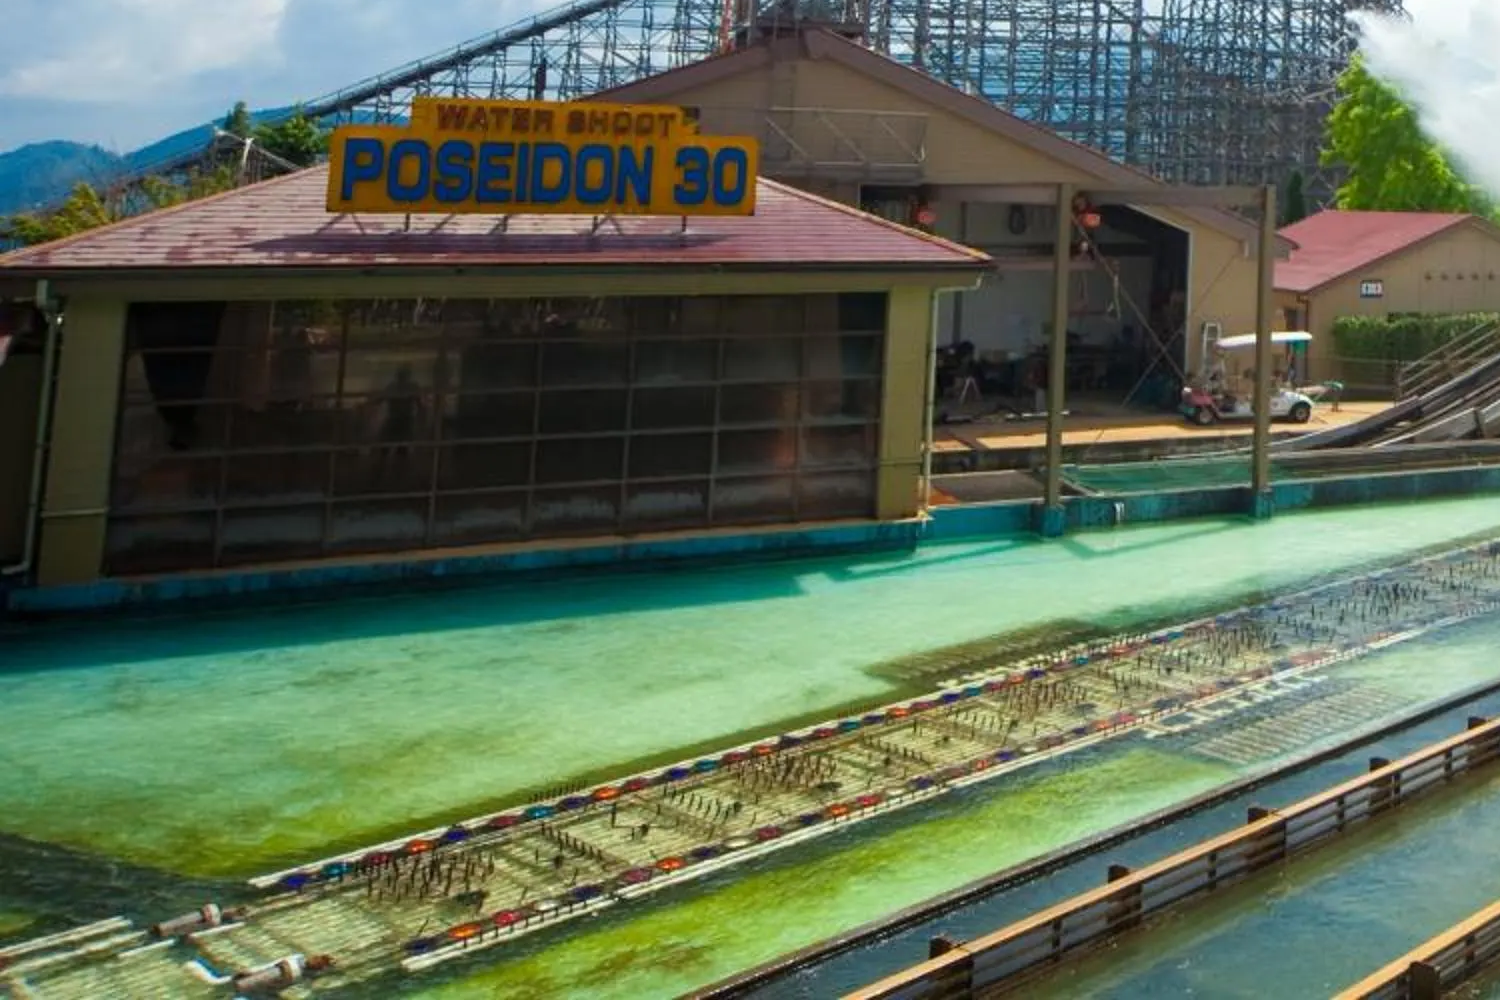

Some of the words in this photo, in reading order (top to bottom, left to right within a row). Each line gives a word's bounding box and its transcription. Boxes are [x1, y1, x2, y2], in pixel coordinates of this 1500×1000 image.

[436, 103, 554, 135] WATER
[566, 109, 677, 138] SHOOT
[341, 137, 653, 206] POSEIDON
[673, 146, 748, 206] 30
